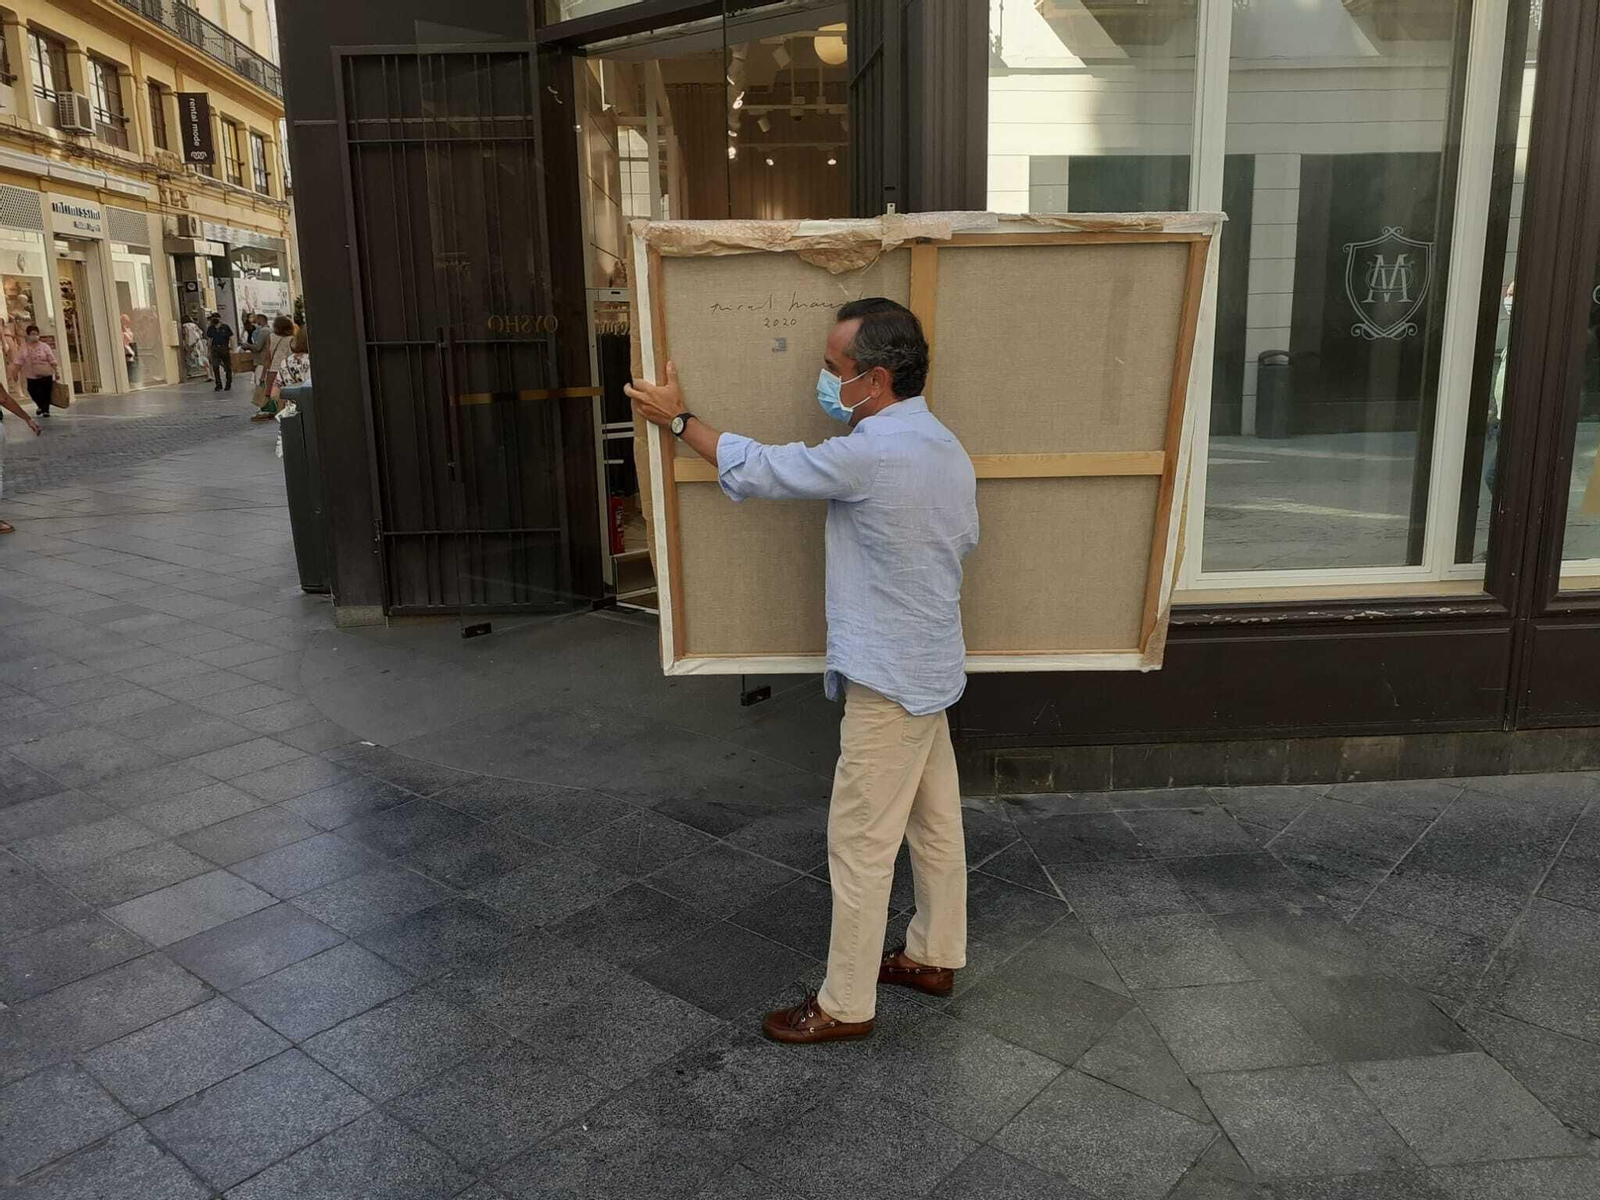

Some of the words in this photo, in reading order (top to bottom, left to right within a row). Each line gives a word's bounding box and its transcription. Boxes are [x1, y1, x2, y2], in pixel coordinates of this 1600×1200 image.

[189, 98, 198, 122] rental
[191, 123, 201, 147] mode
[763, 317, 797, 328] 2020
